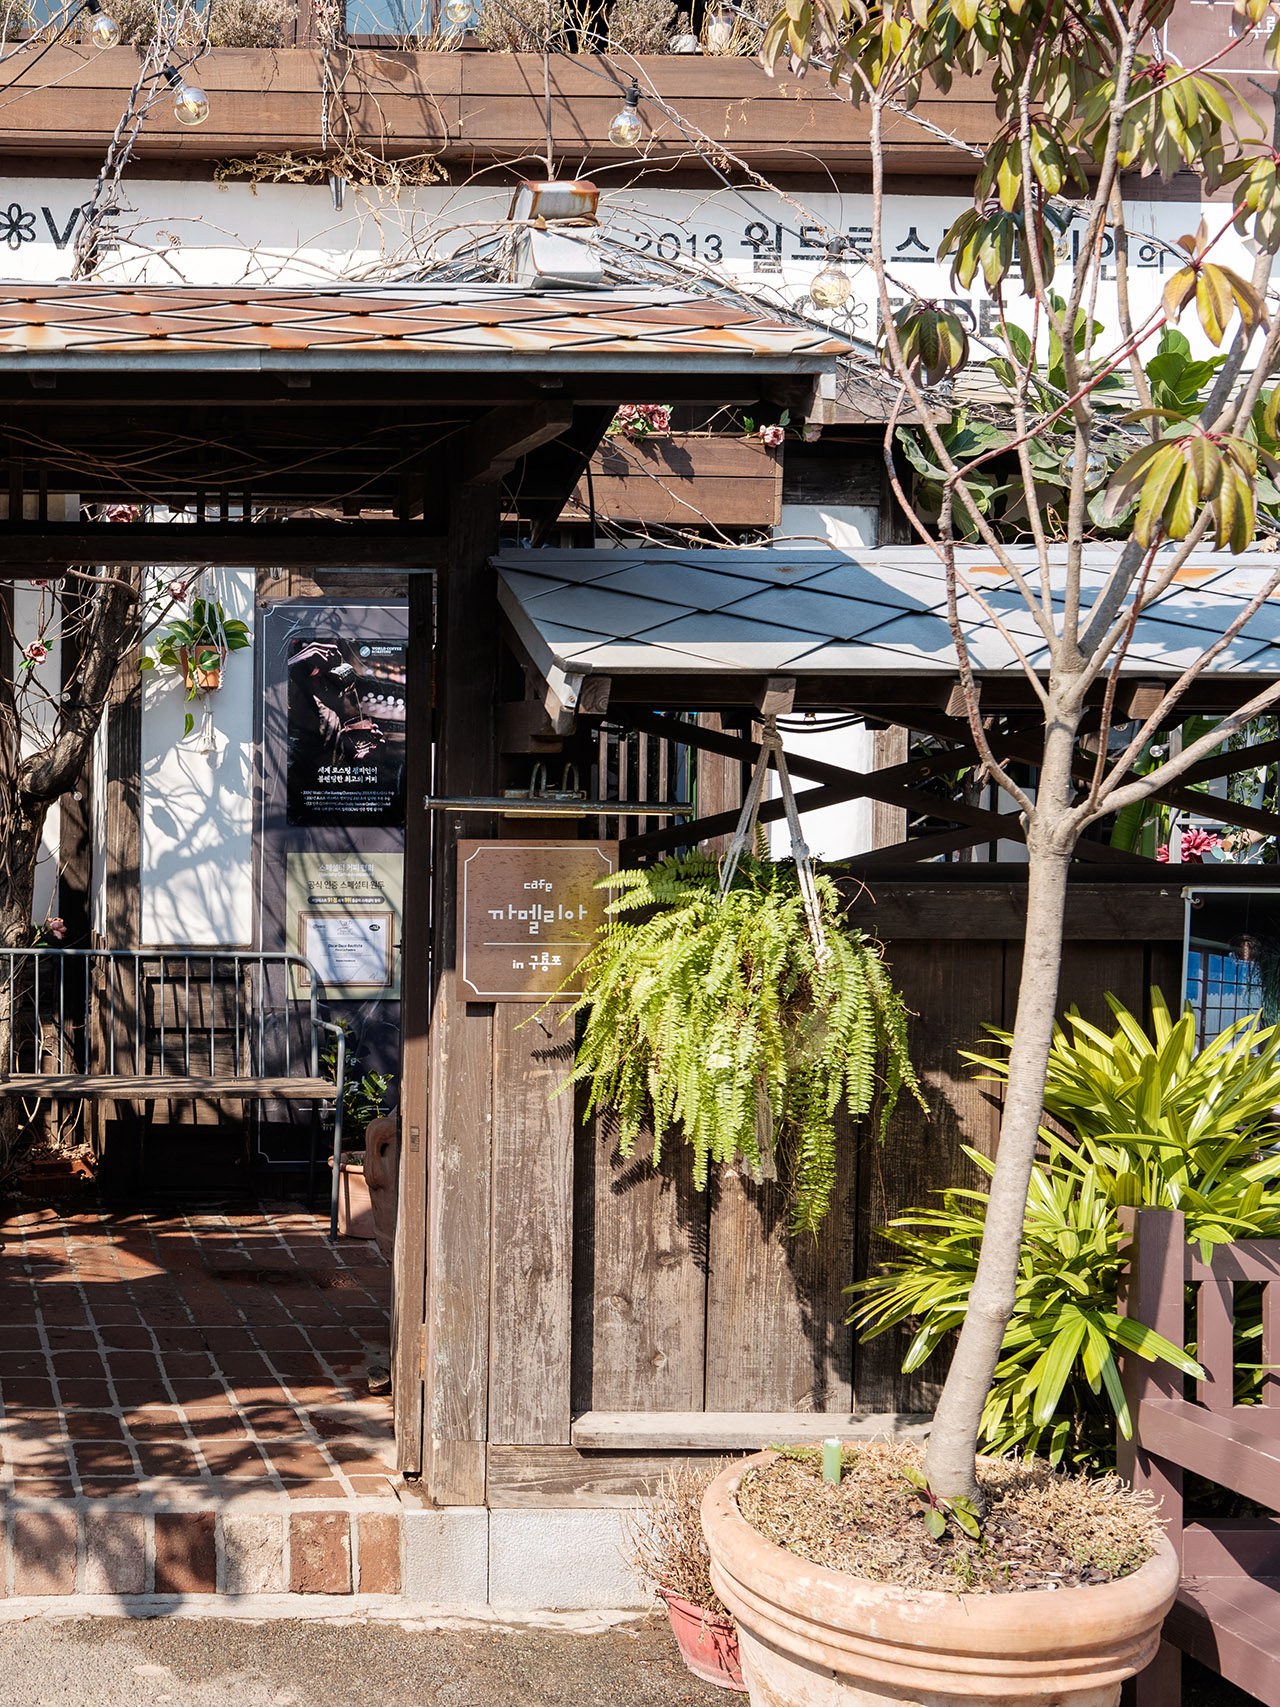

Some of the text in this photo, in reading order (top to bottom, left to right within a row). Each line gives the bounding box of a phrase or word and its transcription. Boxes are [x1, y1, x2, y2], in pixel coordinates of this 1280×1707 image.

[634, 231, 724, 263] 2013
[308, 880, 385, 890] 공식 인증 스페셜티 원두
[523, 879, 553, 893] cafe
[487, 903, 589, 935] 까멜리아
[512, 951, 563, 973] in 구룡포
